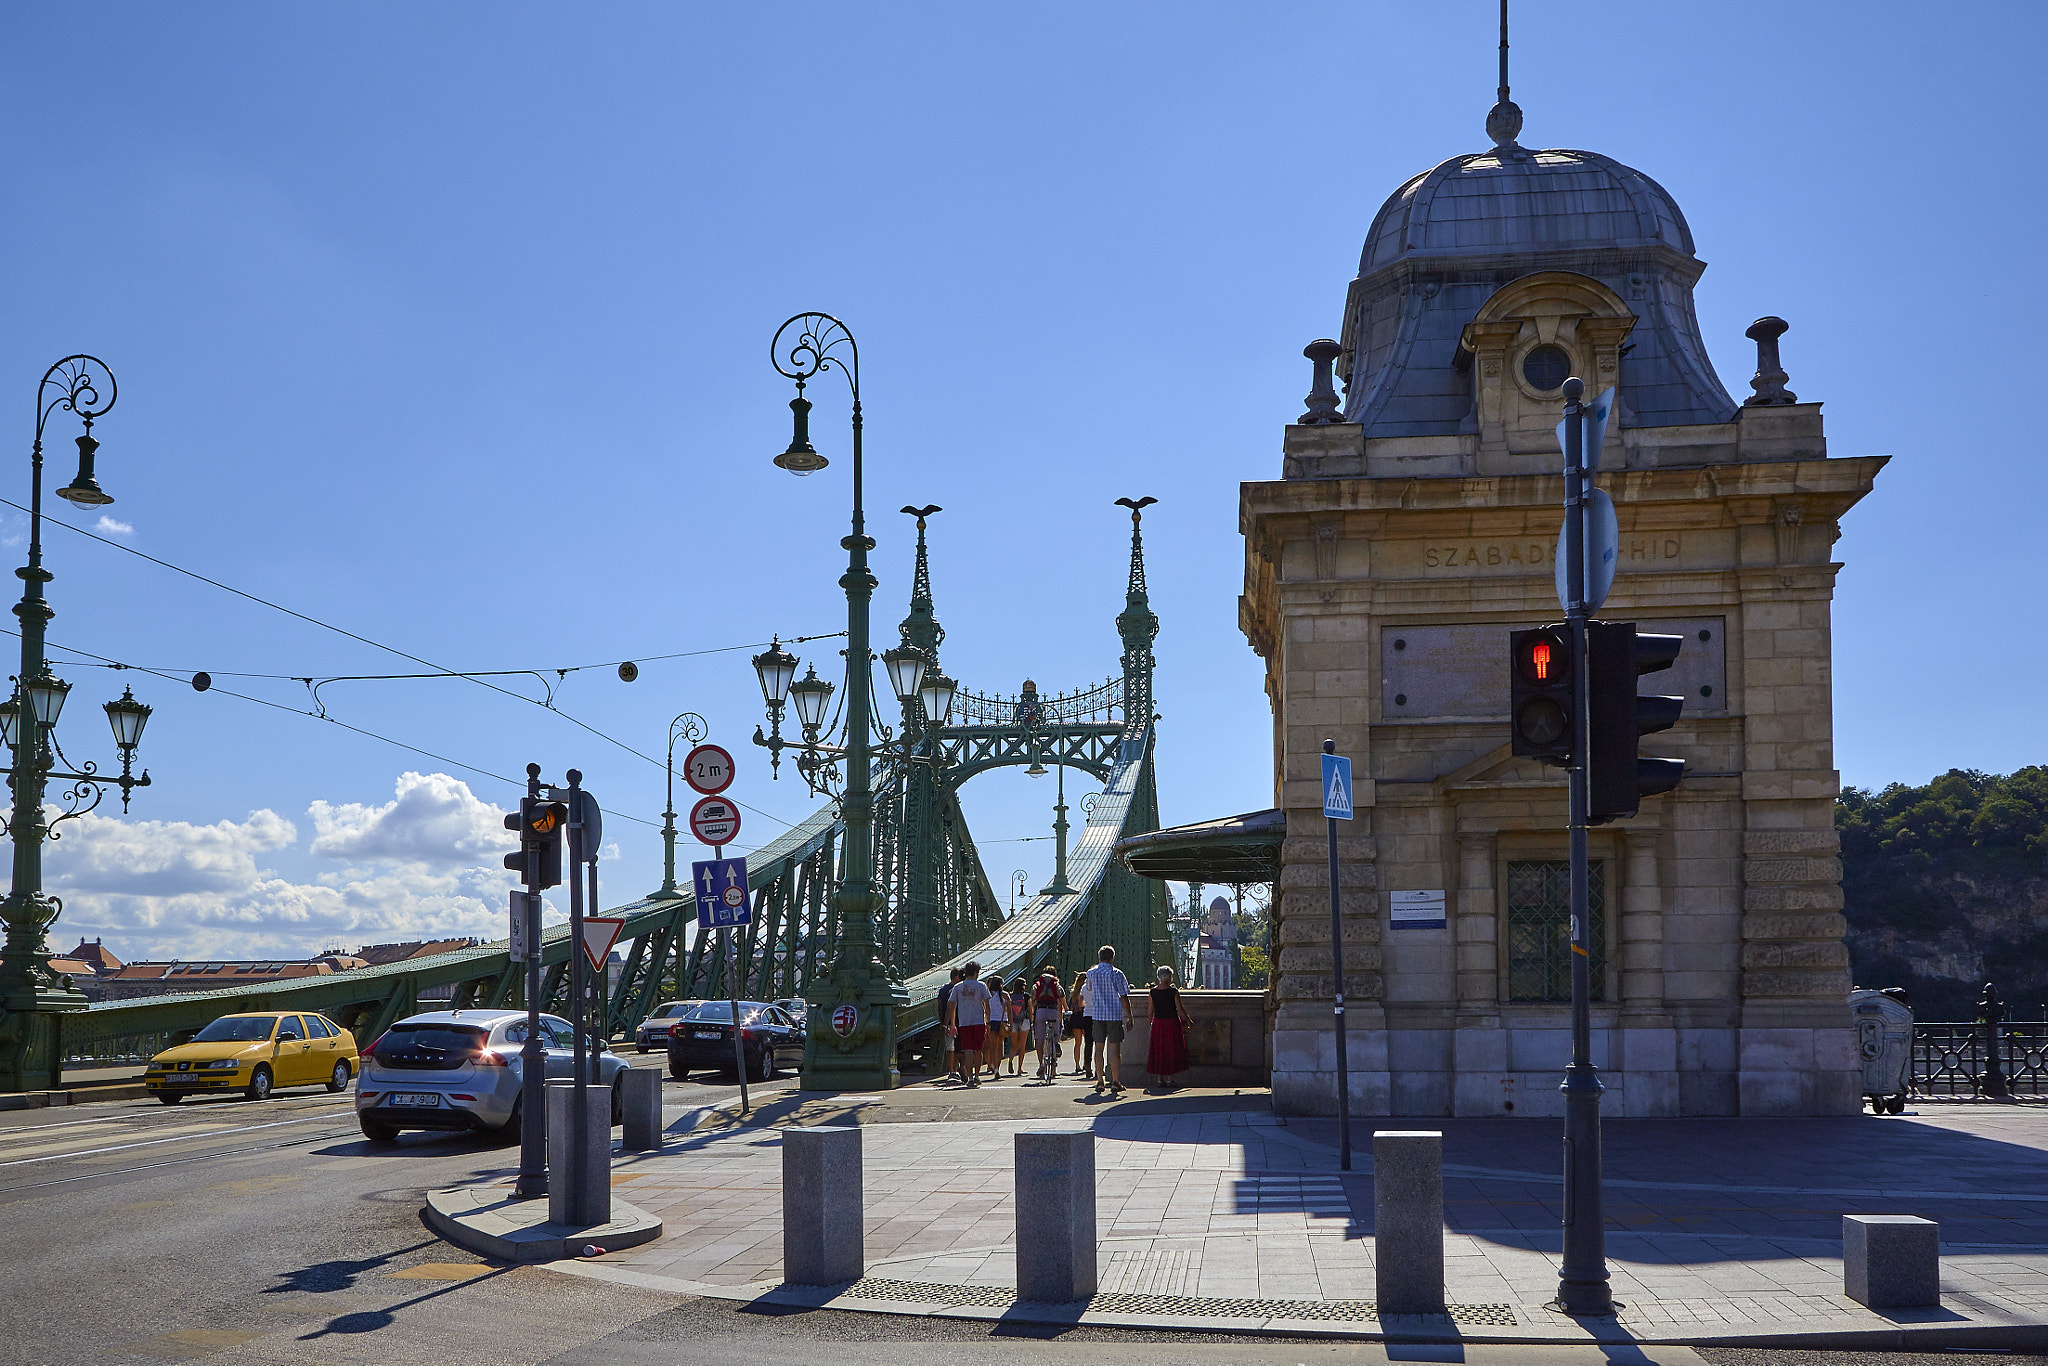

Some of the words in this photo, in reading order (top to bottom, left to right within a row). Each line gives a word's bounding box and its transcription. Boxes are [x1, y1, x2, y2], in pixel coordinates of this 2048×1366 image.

[622, 666, 634, 677] 30
[697, 762, 705, 778] 2
[709, 765, 721, 777] m
